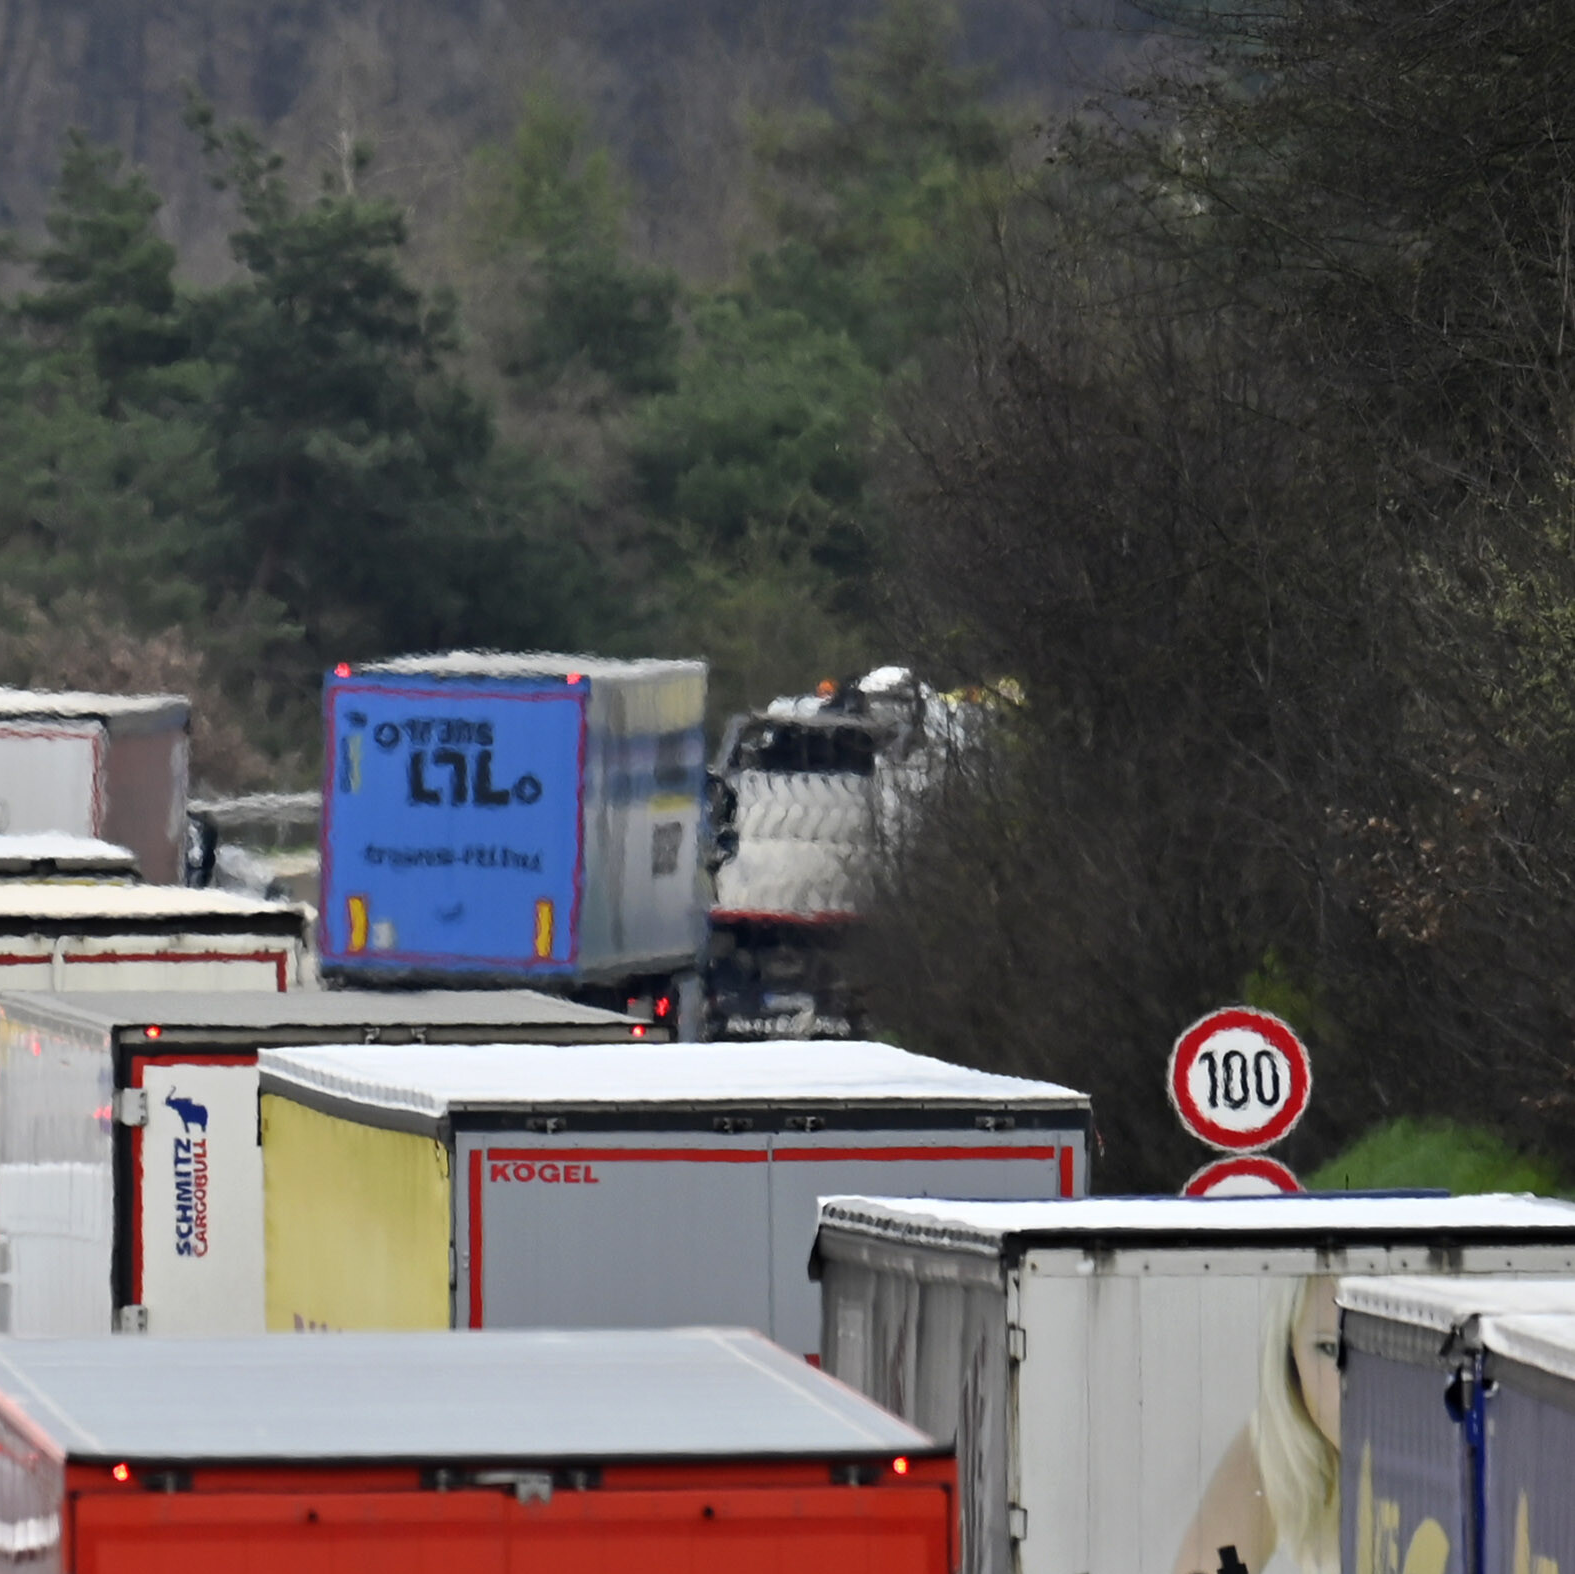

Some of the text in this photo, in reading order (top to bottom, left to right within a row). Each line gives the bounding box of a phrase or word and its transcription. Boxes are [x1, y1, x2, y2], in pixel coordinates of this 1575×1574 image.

[1199, 1050, 1280, 1109] 100
[174, 1137, 193, 1256] SCHMITZ
[193, 1137, 208, 1258] CARGOBULL
[490, 1161, 600, 1183] KÖGEL
